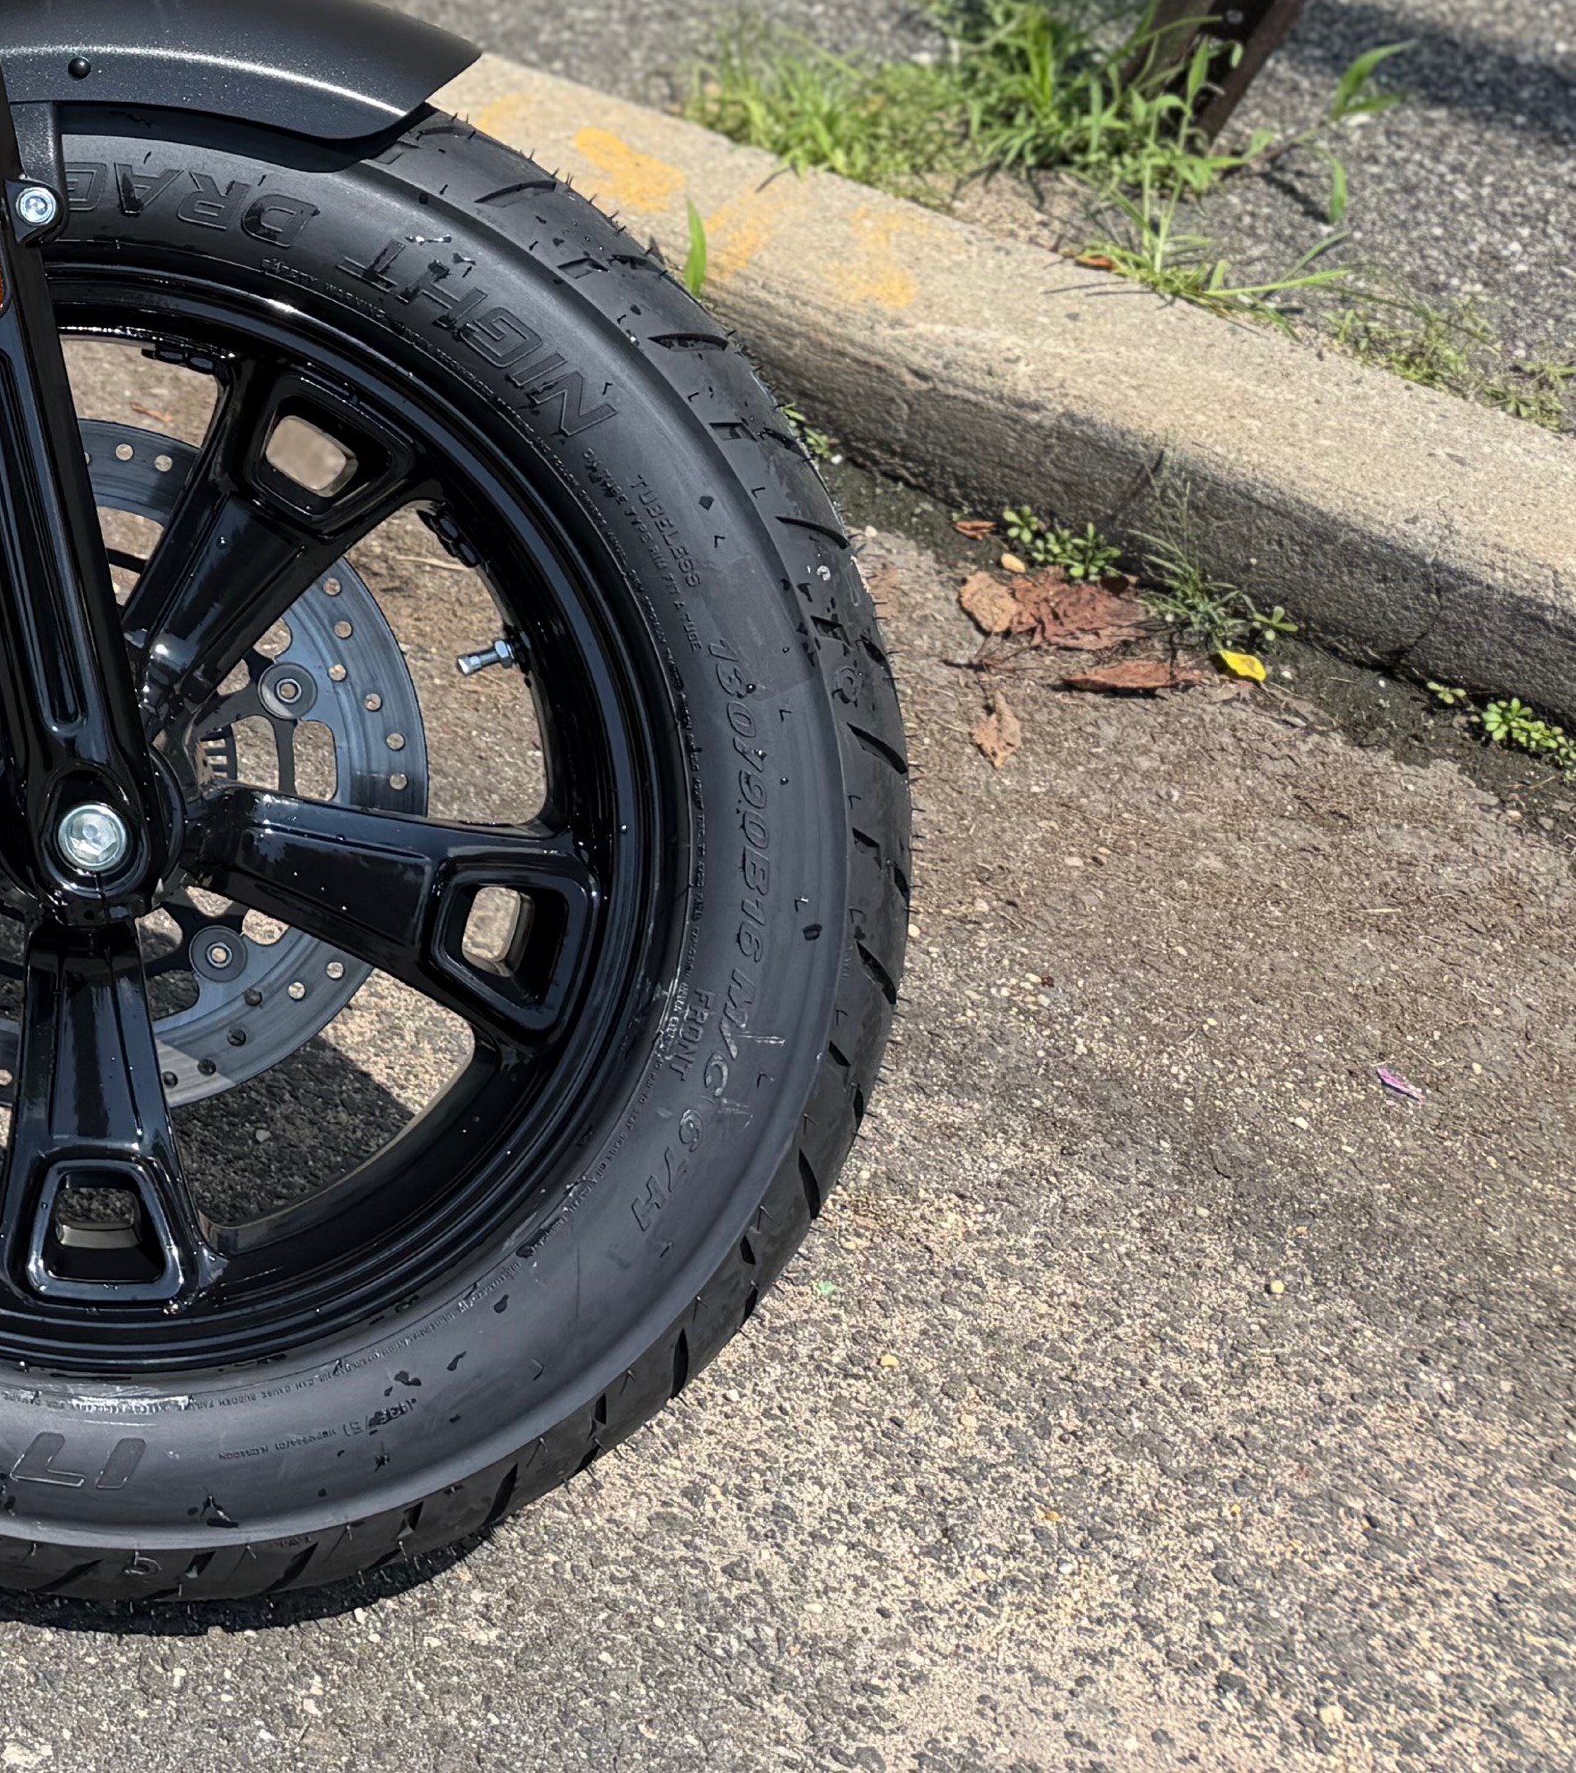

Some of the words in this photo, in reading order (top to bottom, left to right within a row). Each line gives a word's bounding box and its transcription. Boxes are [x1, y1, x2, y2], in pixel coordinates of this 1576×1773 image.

[341, 237, 618, 439] NIGHT
[621, 504, 655, 545] TYPE
[645, 543, 670, 571] RIM
[659, 570, 682, 598] FIT
[676, 611, 705, 652] TUBE
[626, 473, 705, 589] TUBELESS
[663, 986, 716, 1084] FRONT
[629, 1105, 707, 1234] 67H
